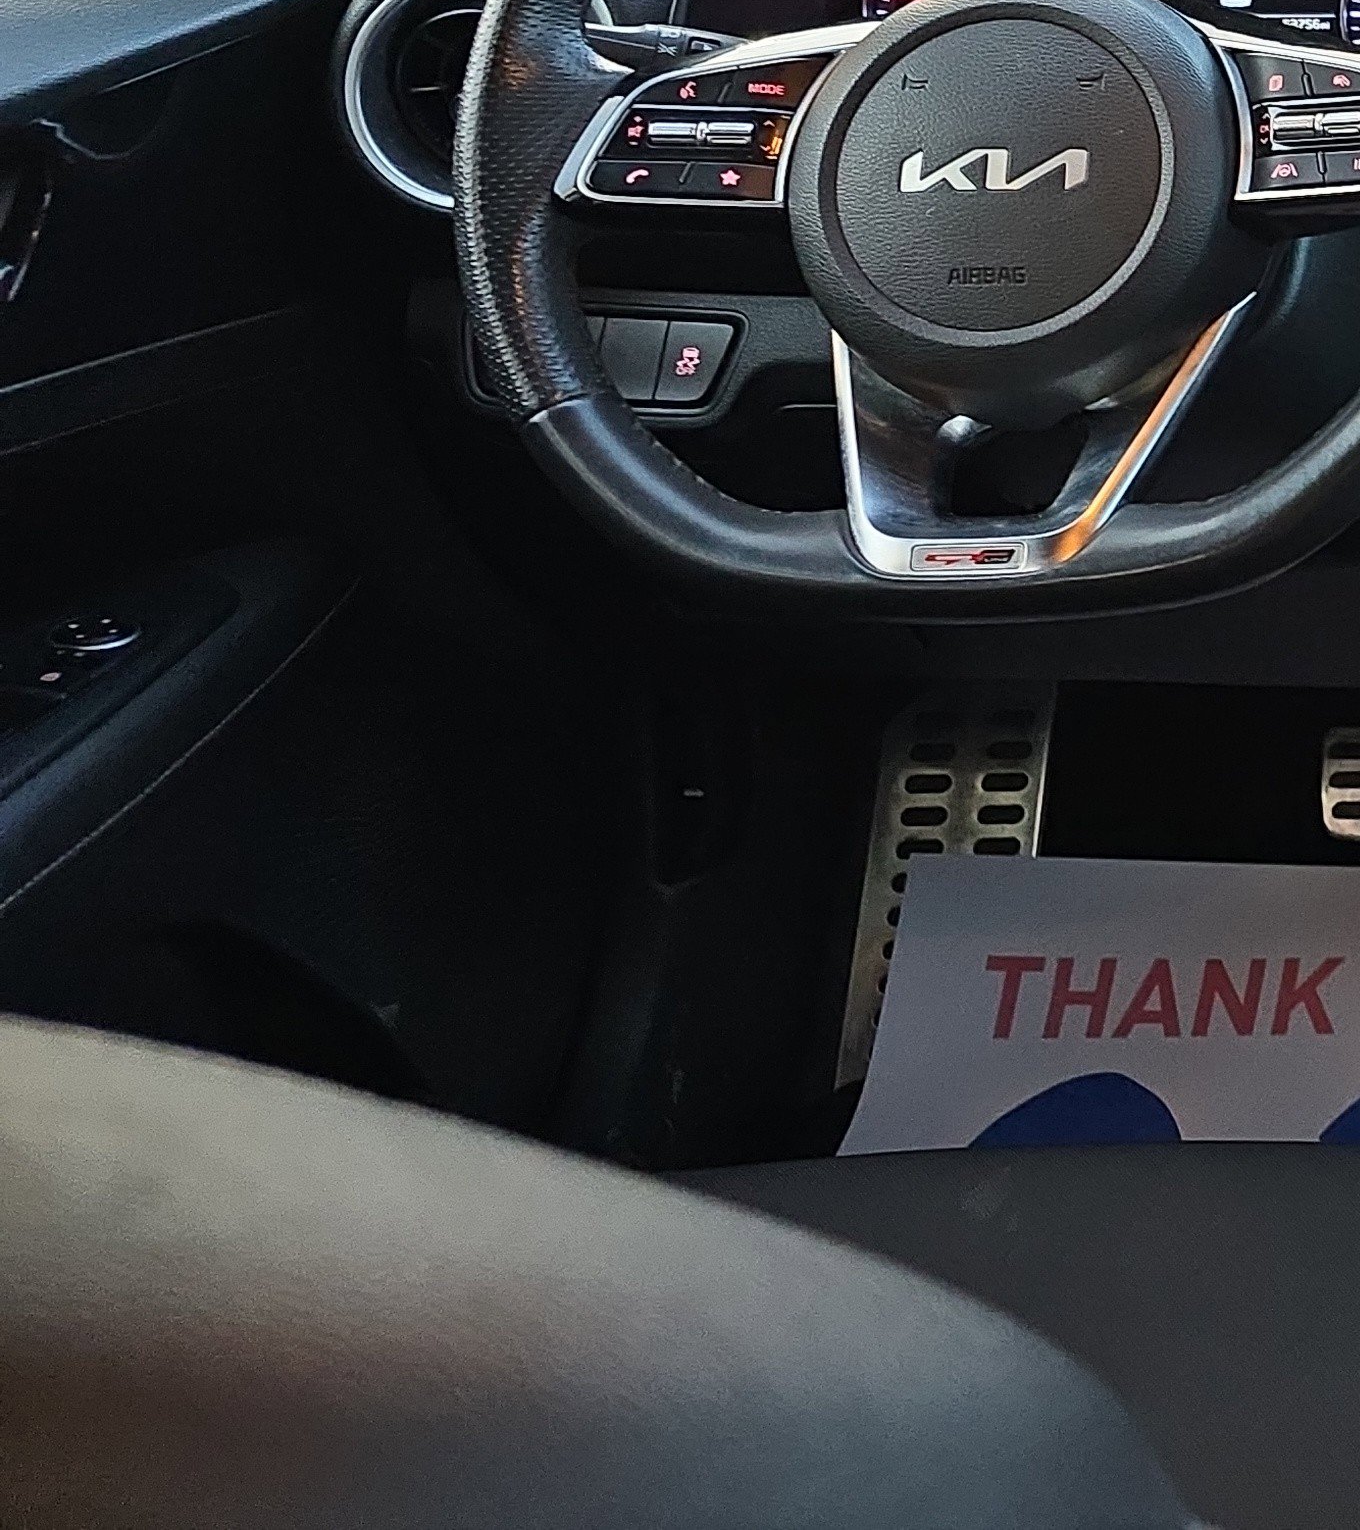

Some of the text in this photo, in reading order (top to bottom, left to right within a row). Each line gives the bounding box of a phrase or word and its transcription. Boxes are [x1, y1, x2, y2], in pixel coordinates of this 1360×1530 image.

[747, 83, 785, 96] MODE
[947, 267, 1027, 286] AIRBAG
[984, 953, 1346, 1040] THANK
